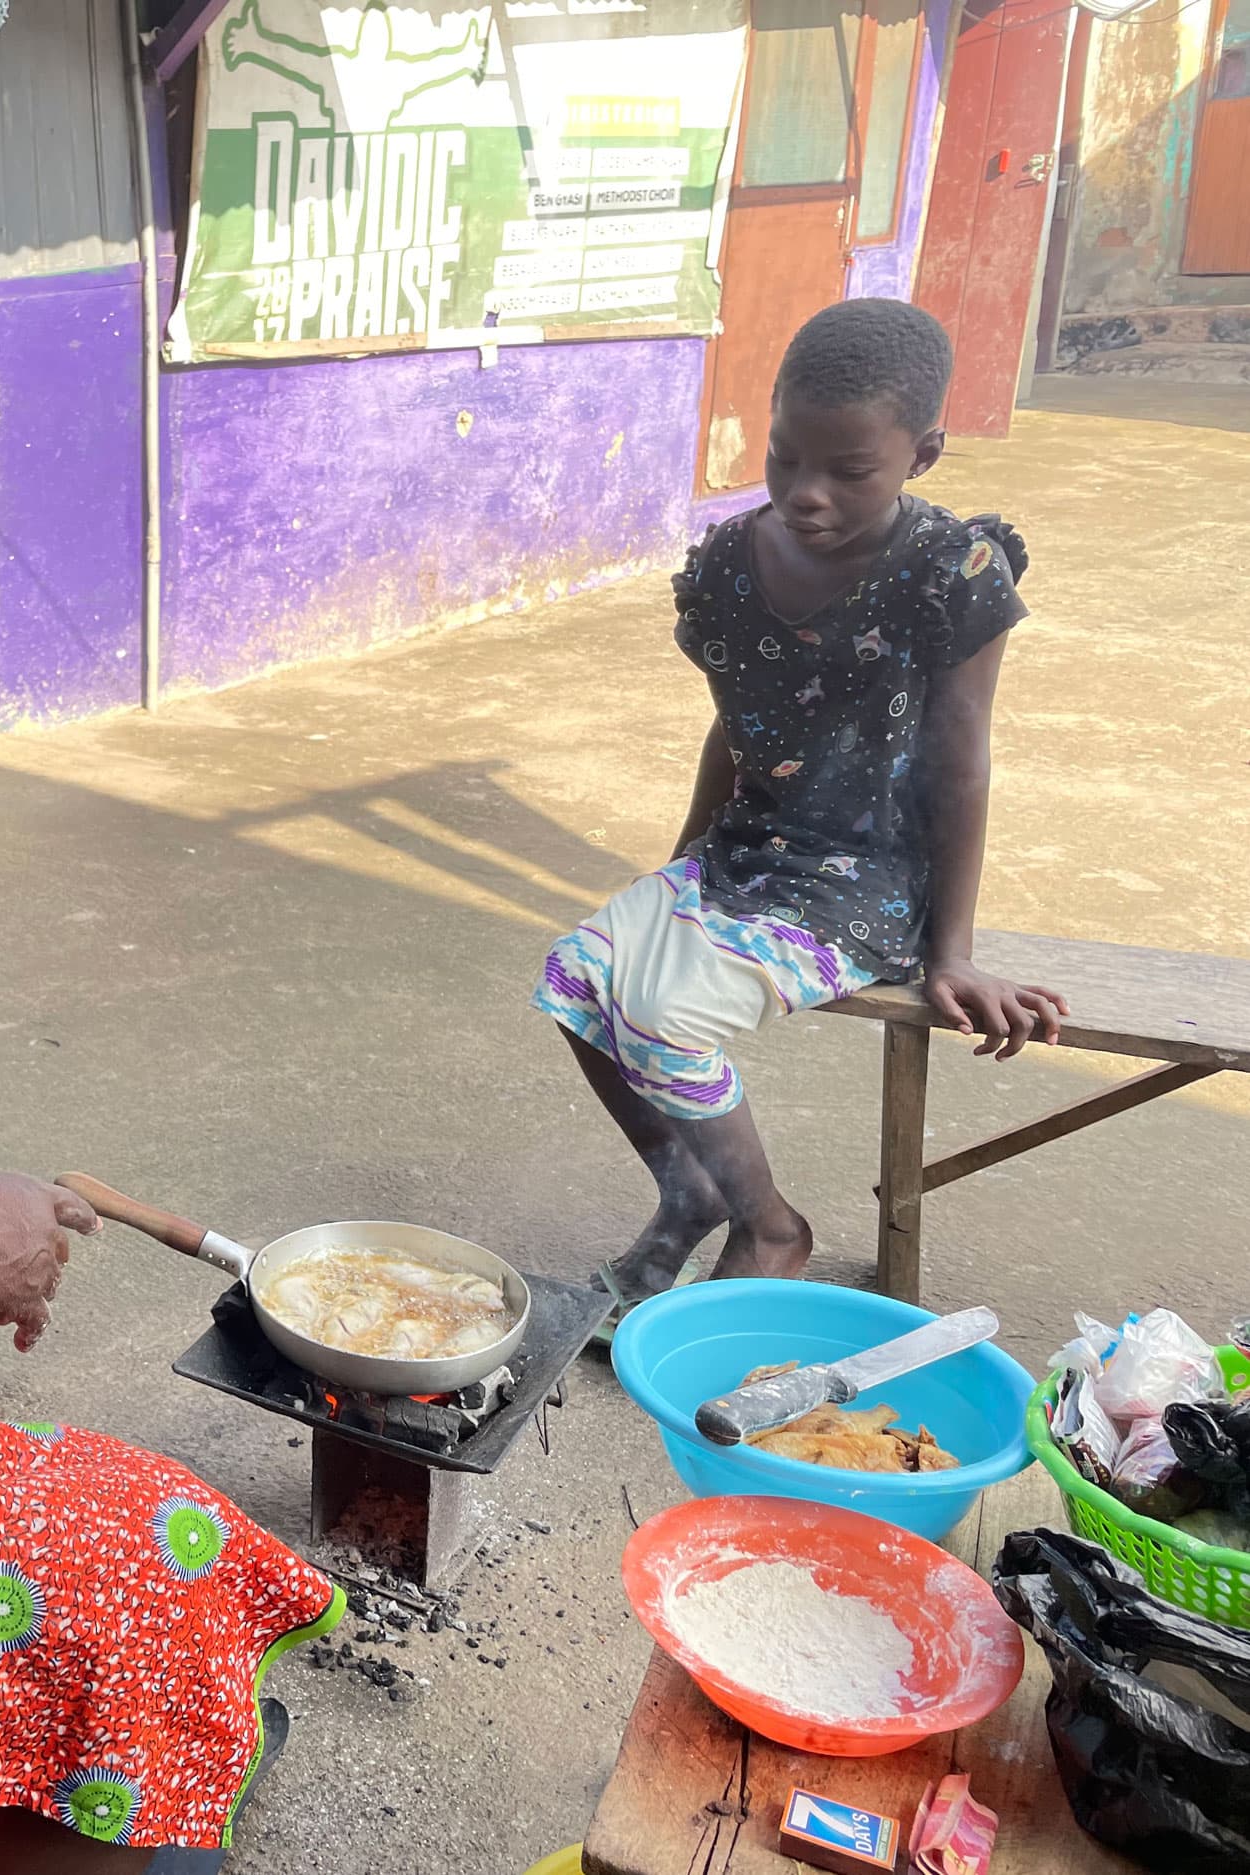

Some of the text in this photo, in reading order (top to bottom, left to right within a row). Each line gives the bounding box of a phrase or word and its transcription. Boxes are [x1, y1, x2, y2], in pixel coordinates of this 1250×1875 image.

[252, 120, 467, 264] DAVIDIC
[288, 243, 461, 345] PRAISE
[790, 1794, 856, 1840] 7
[852, 1811, 873, 1853] DAYS
